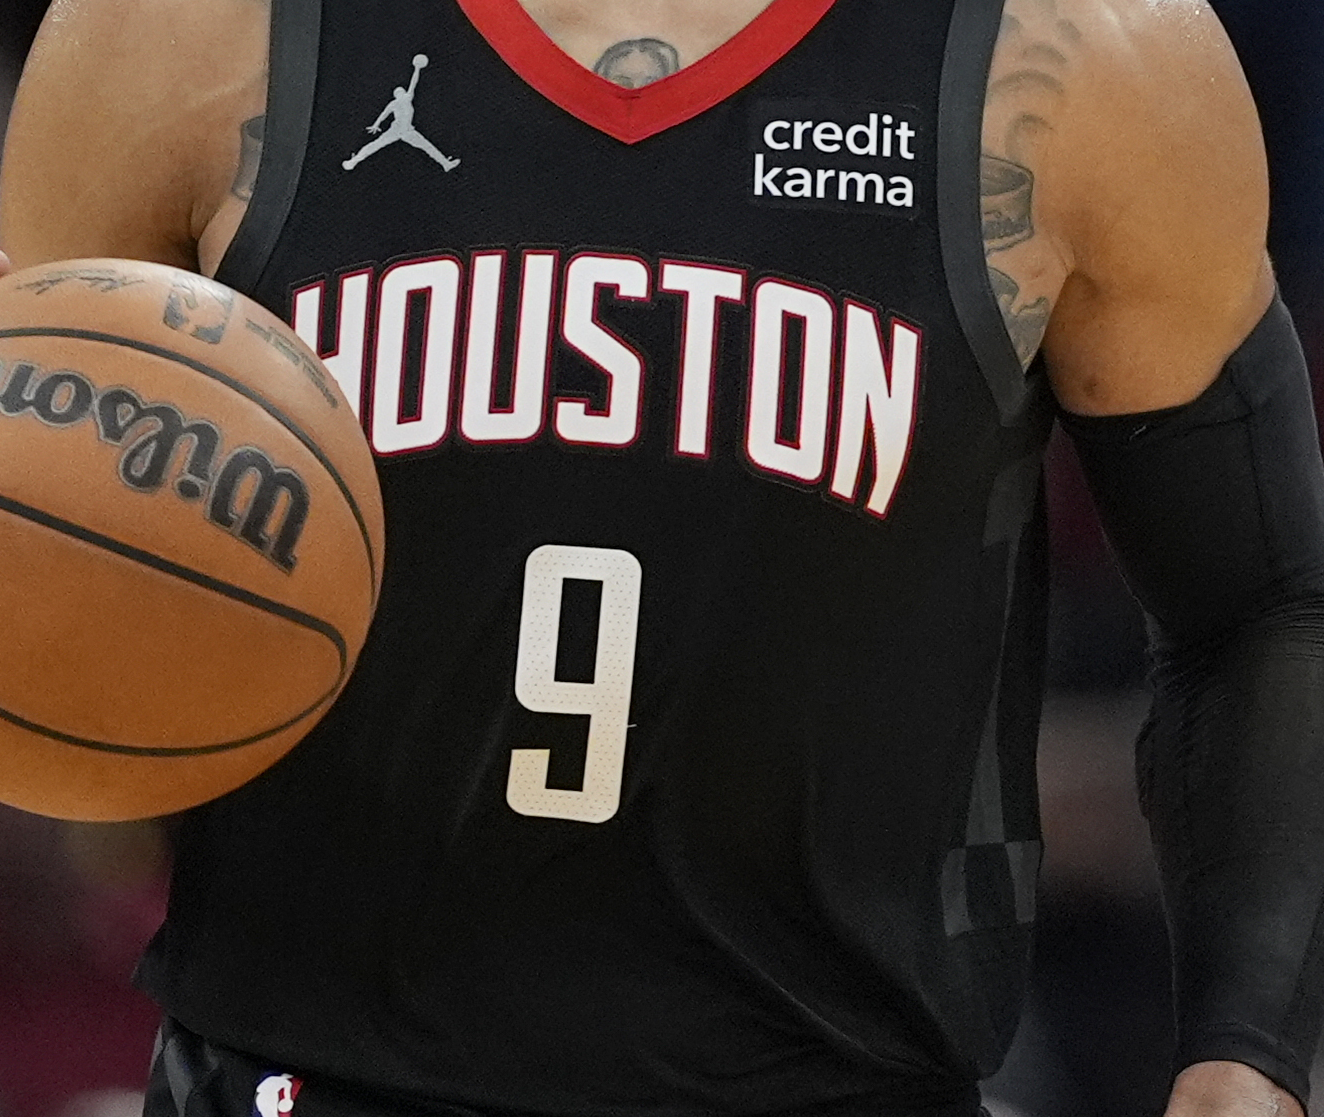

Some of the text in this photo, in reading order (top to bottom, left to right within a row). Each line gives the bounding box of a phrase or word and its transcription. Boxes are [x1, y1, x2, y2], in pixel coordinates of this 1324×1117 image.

[754, 153, 914, 207] karma
[763, 113, 915, 160] credit
[291, 249, 922, 520] HOUSTON
[506, 544, 642, 824] 9
